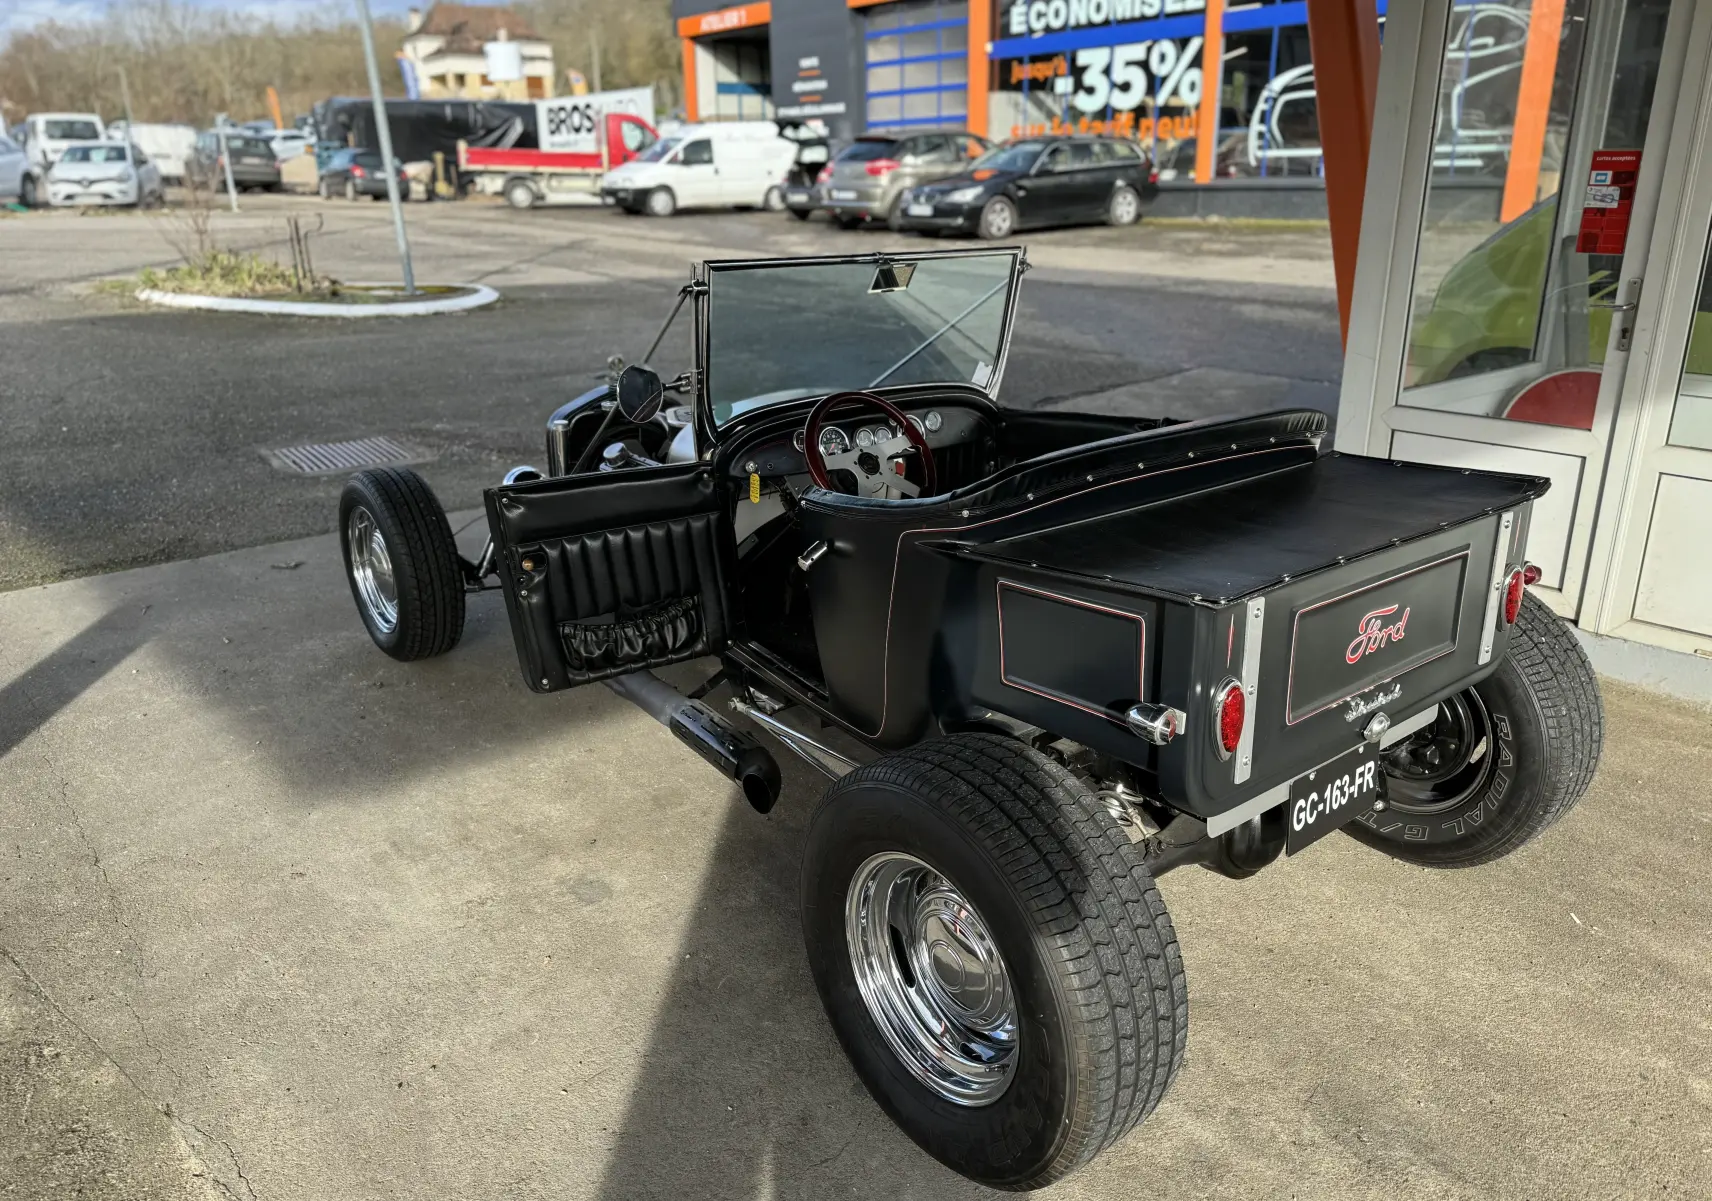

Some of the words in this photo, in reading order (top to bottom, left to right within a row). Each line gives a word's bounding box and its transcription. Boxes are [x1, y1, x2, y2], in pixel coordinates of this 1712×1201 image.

[1054, 36, 1203, 113] -35%
[547, 103, 594, 135] BROS
[1079, 111, 1135, 138] tarif
[1346, 604, 1410, 664] Ford
[1293, 761, 1375, 831] GC-163-FR
[1441, 713, 1514, 836] RADIAL
